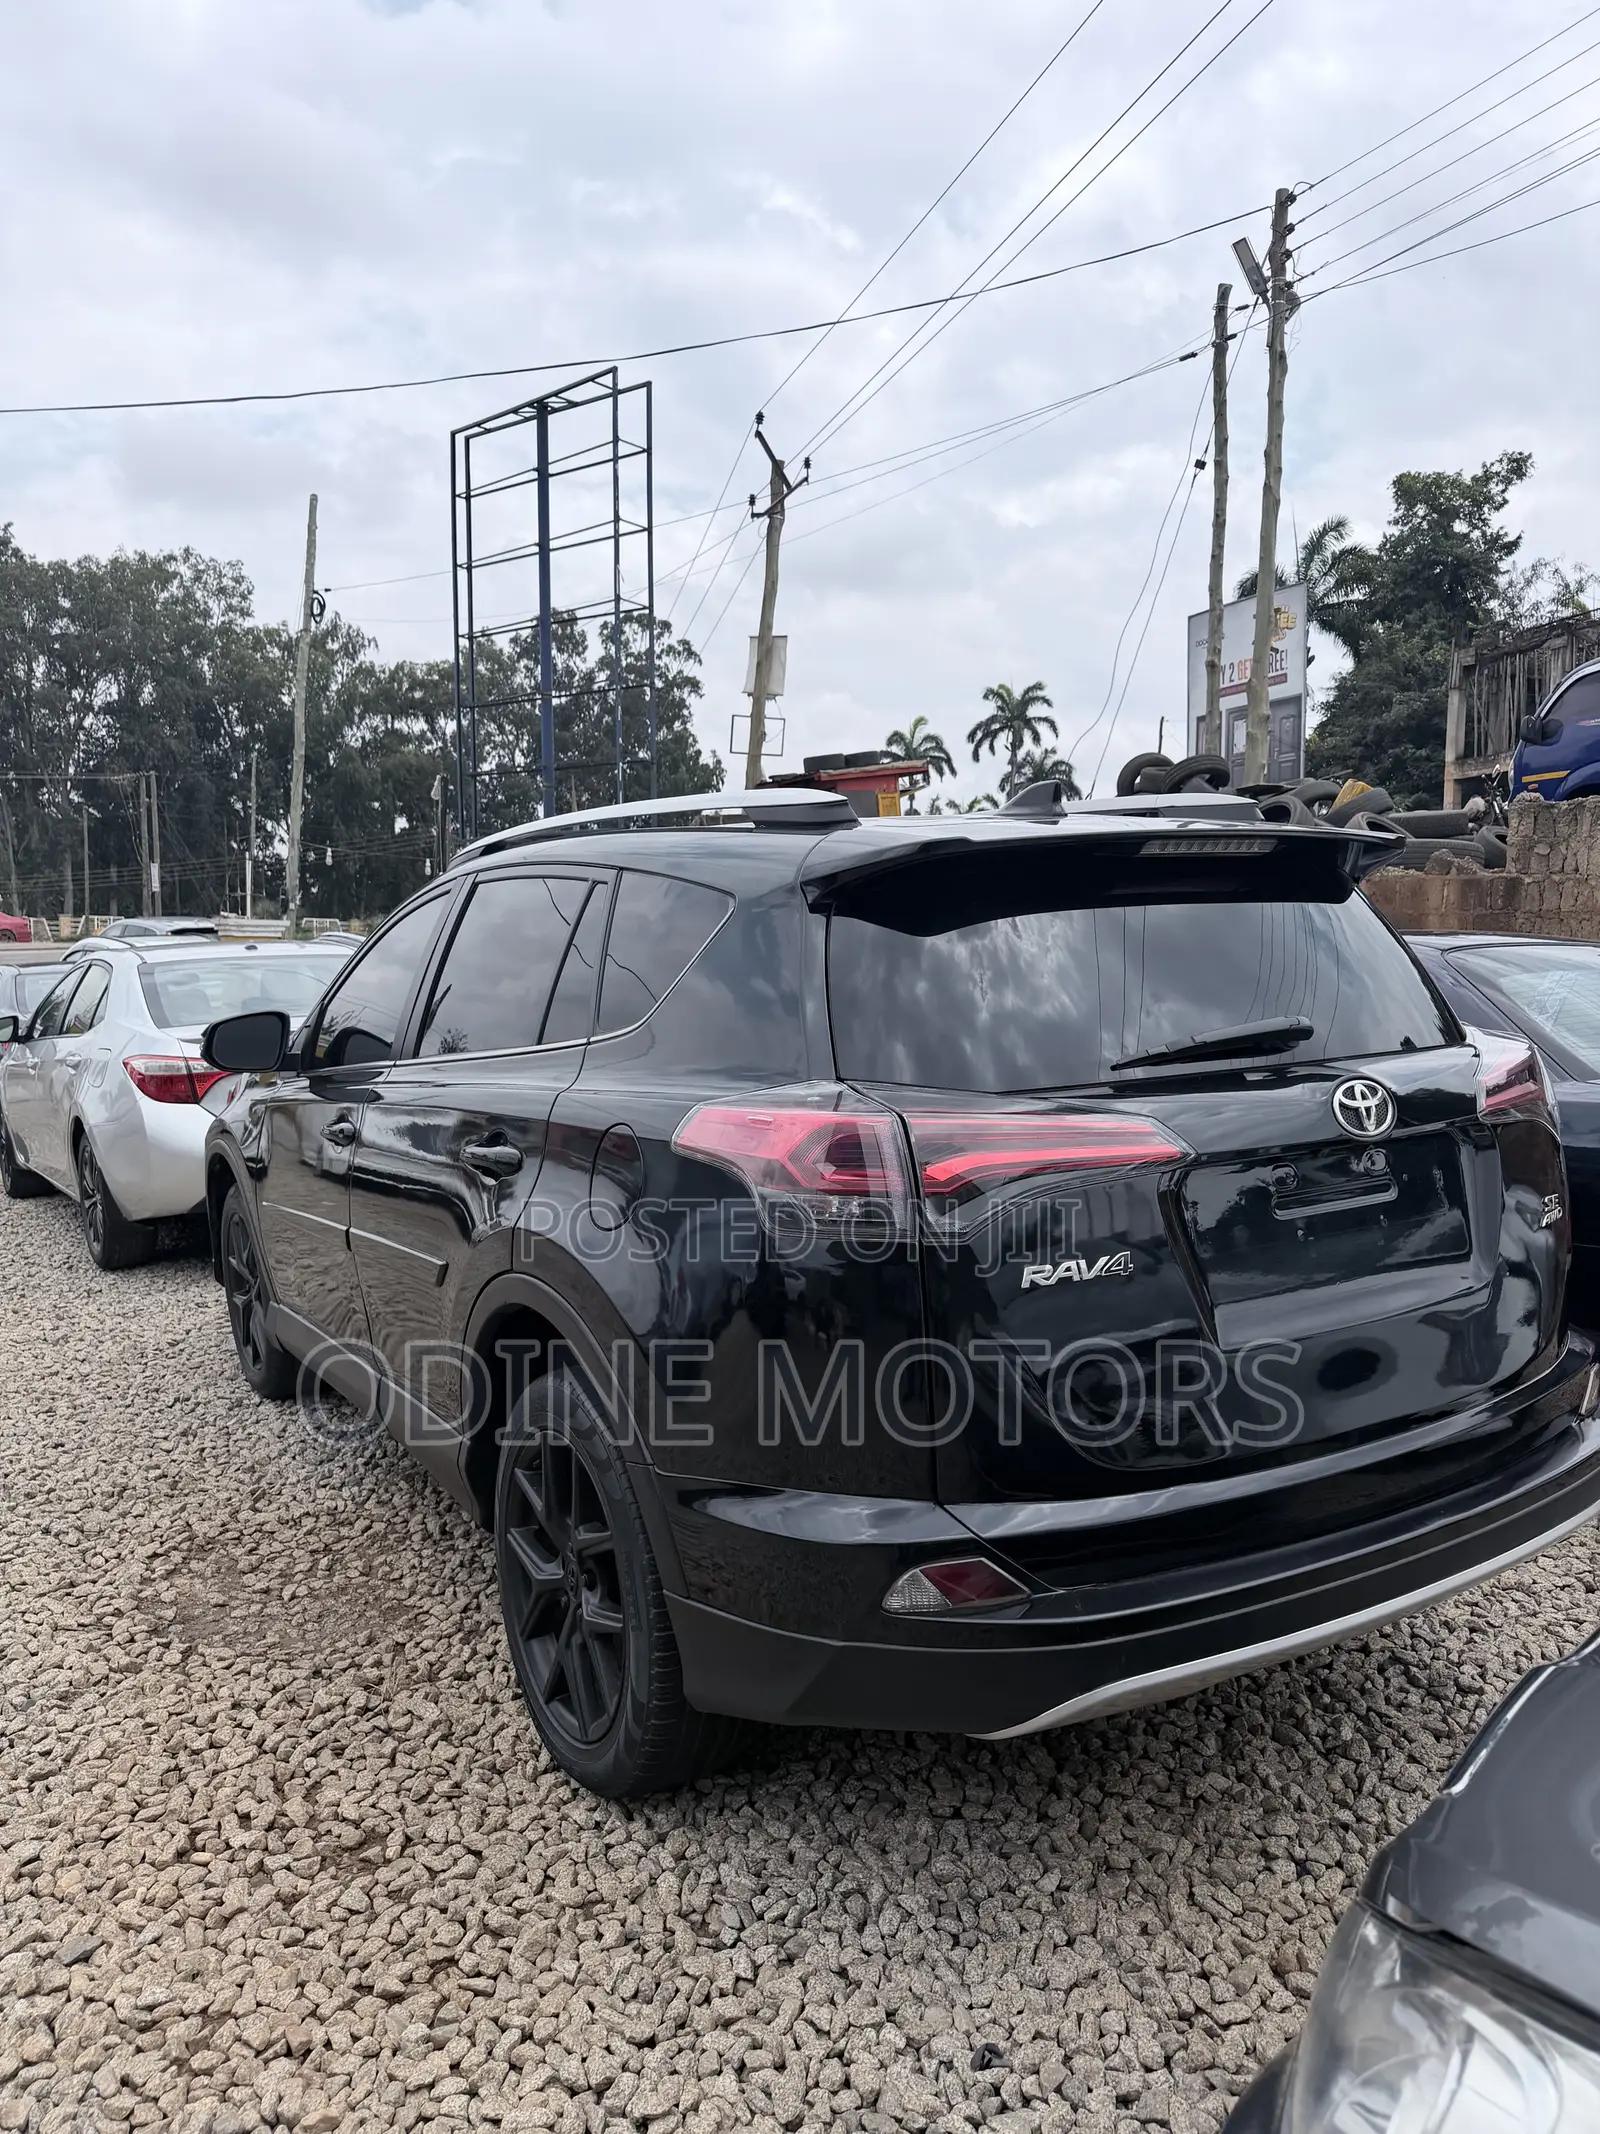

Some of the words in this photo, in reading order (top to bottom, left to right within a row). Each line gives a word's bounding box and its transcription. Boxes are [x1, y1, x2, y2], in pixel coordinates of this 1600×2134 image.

[1229, 662, 1235, 683] 2
[1268, 649, 1288, 674] REE!
[1020, 1251, 1134, 1289] RAV4
